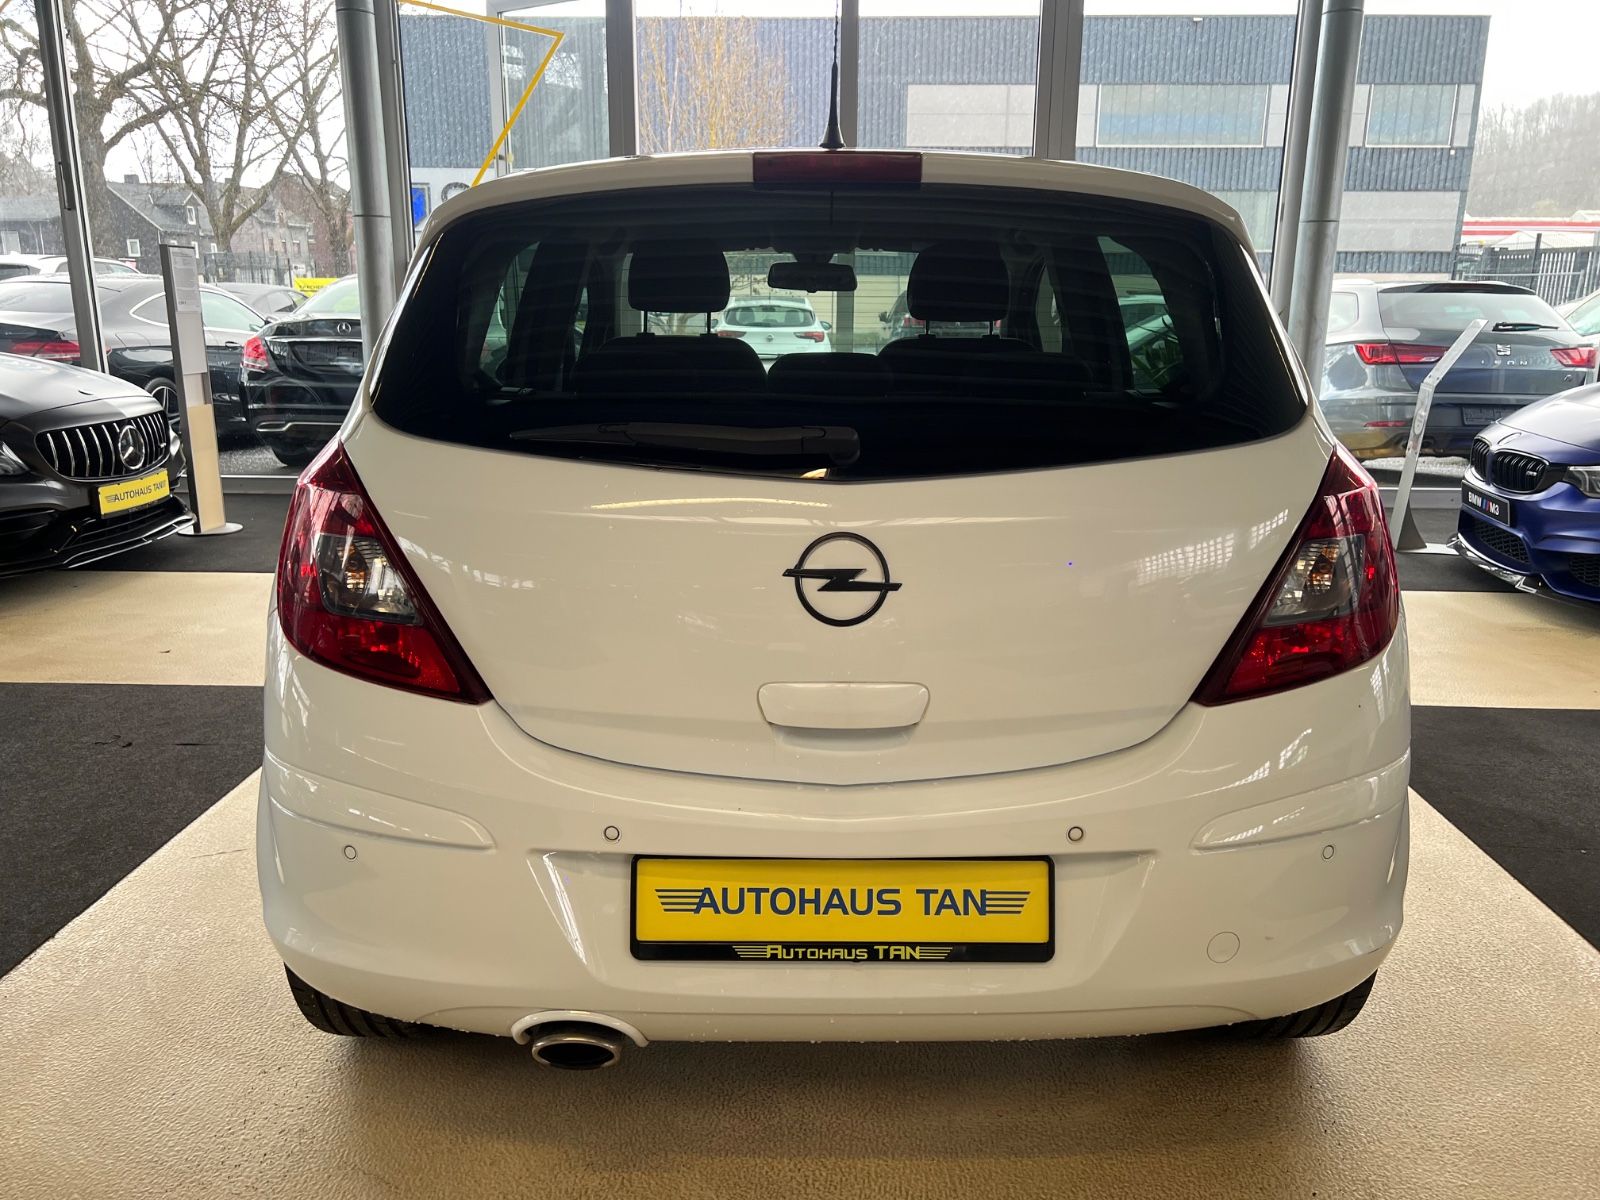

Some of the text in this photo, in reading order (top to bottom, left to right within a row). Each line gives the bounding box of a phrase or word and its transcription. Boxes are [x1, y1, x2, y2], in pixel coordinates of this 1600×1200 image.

[114, 485, 153, 502] AUTOHAUS
[1468, 491, 1500, 516] BMW M3
[693, 886, 987, 917] AUTOHAUS TAN
[766, 944, 921, 960] AUTOHAUS TAN
